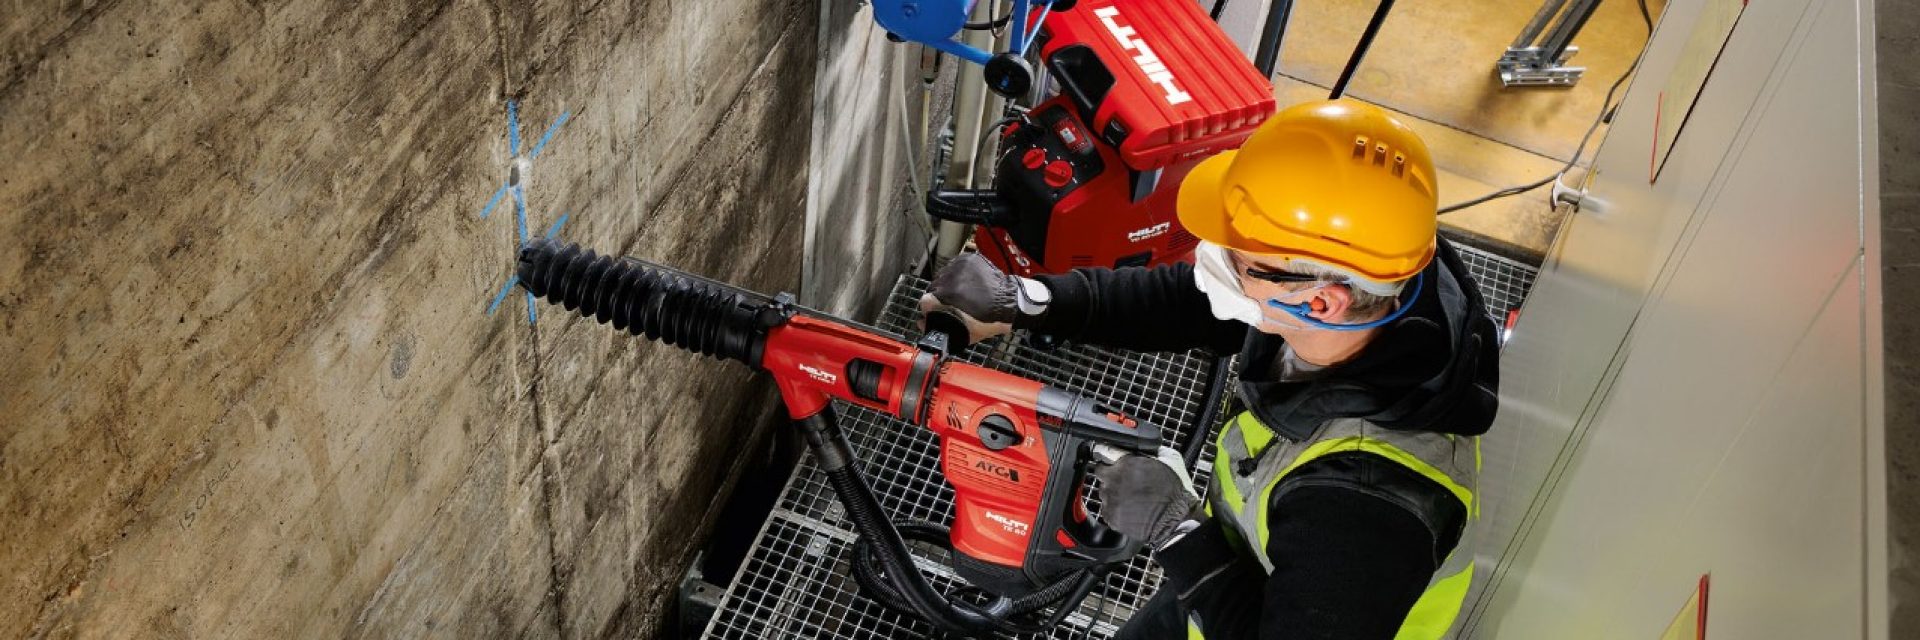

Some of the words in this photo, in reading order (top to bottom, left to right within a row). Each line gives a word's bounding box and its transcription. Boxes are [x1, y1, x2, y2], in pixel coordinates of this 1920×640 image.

[1094, 6, 1192, 105] HILTI
[1128, 221, 1170, 239] HILTI
[799, 363, 836, 381] HILTI
[985, 511, 1028, 531] HILTI
